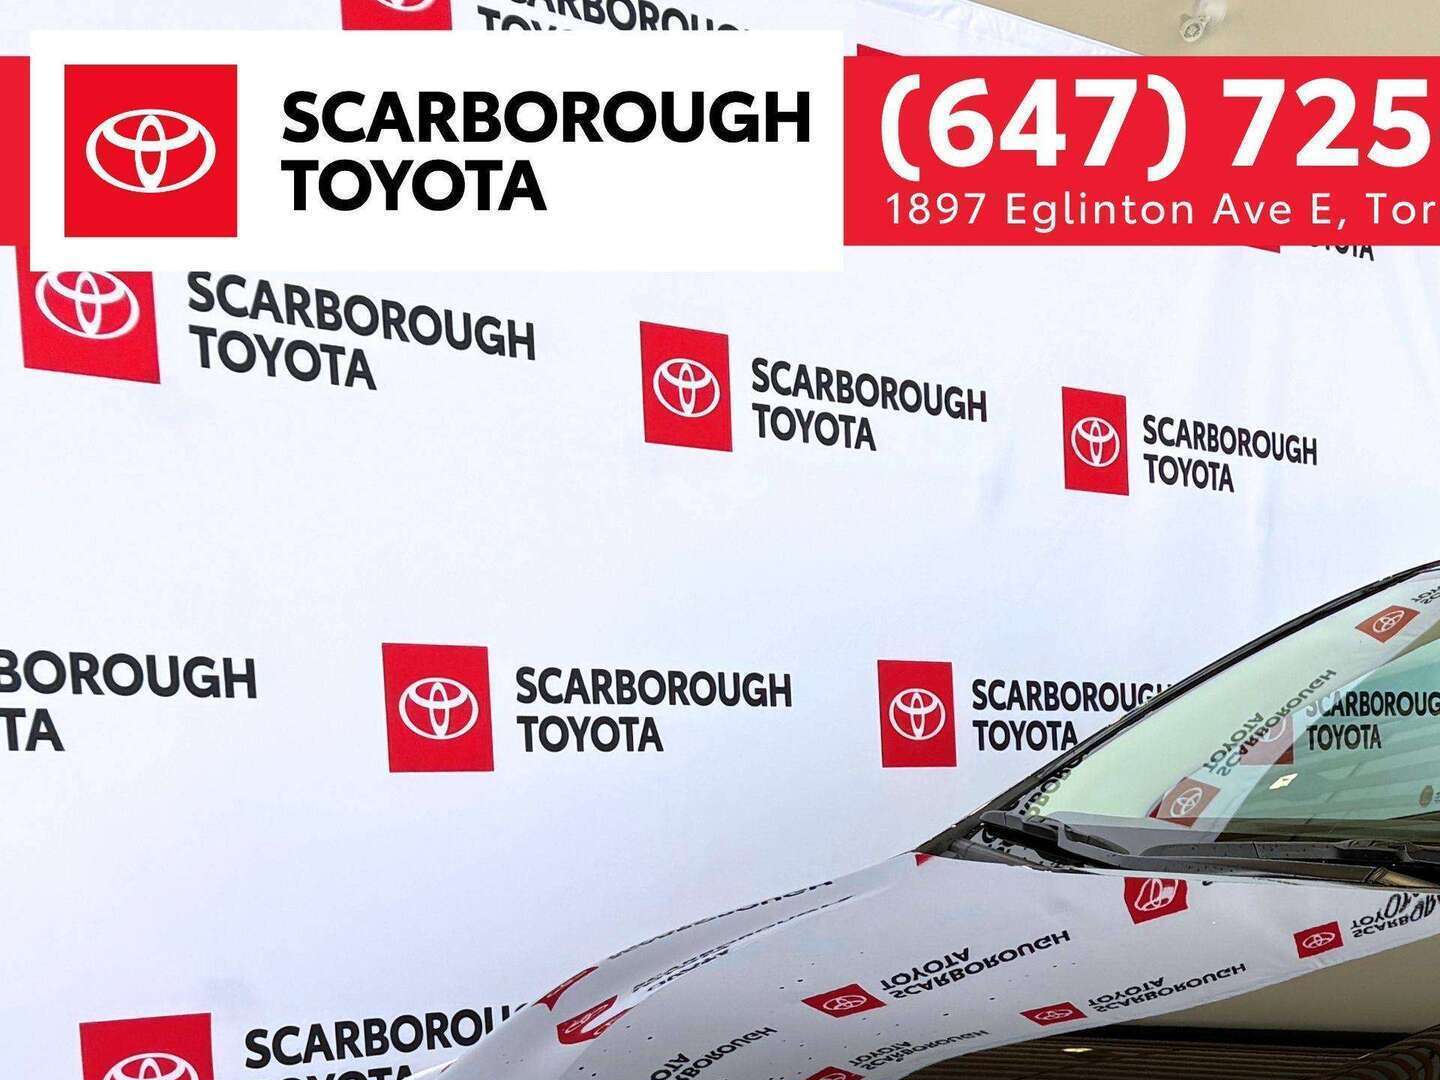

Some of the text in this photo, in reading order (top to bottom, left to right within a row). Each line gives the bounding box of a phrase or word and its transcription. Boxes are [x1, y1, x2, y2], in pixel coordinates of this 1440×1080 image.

[187, 271, 537, 362] SCARBOROUGH
[187, 323, 378, 392] TOYOTA
[750, 356, 989, 424] SCARBOROUGH
[750, 401, 878, 453] TOYOTA
[1141, 413, 1318, 467] SCARBOROUGH
[1142, 452, 1236, 494] TOYOTA
[515, 665, 793, 709] SCARBOROUGH
[515, 714, 665, 754] TOYOTA
[971, 718, 1079, 752] TOYOTA
[1306, 723, 1383, 752] TOYOTA
